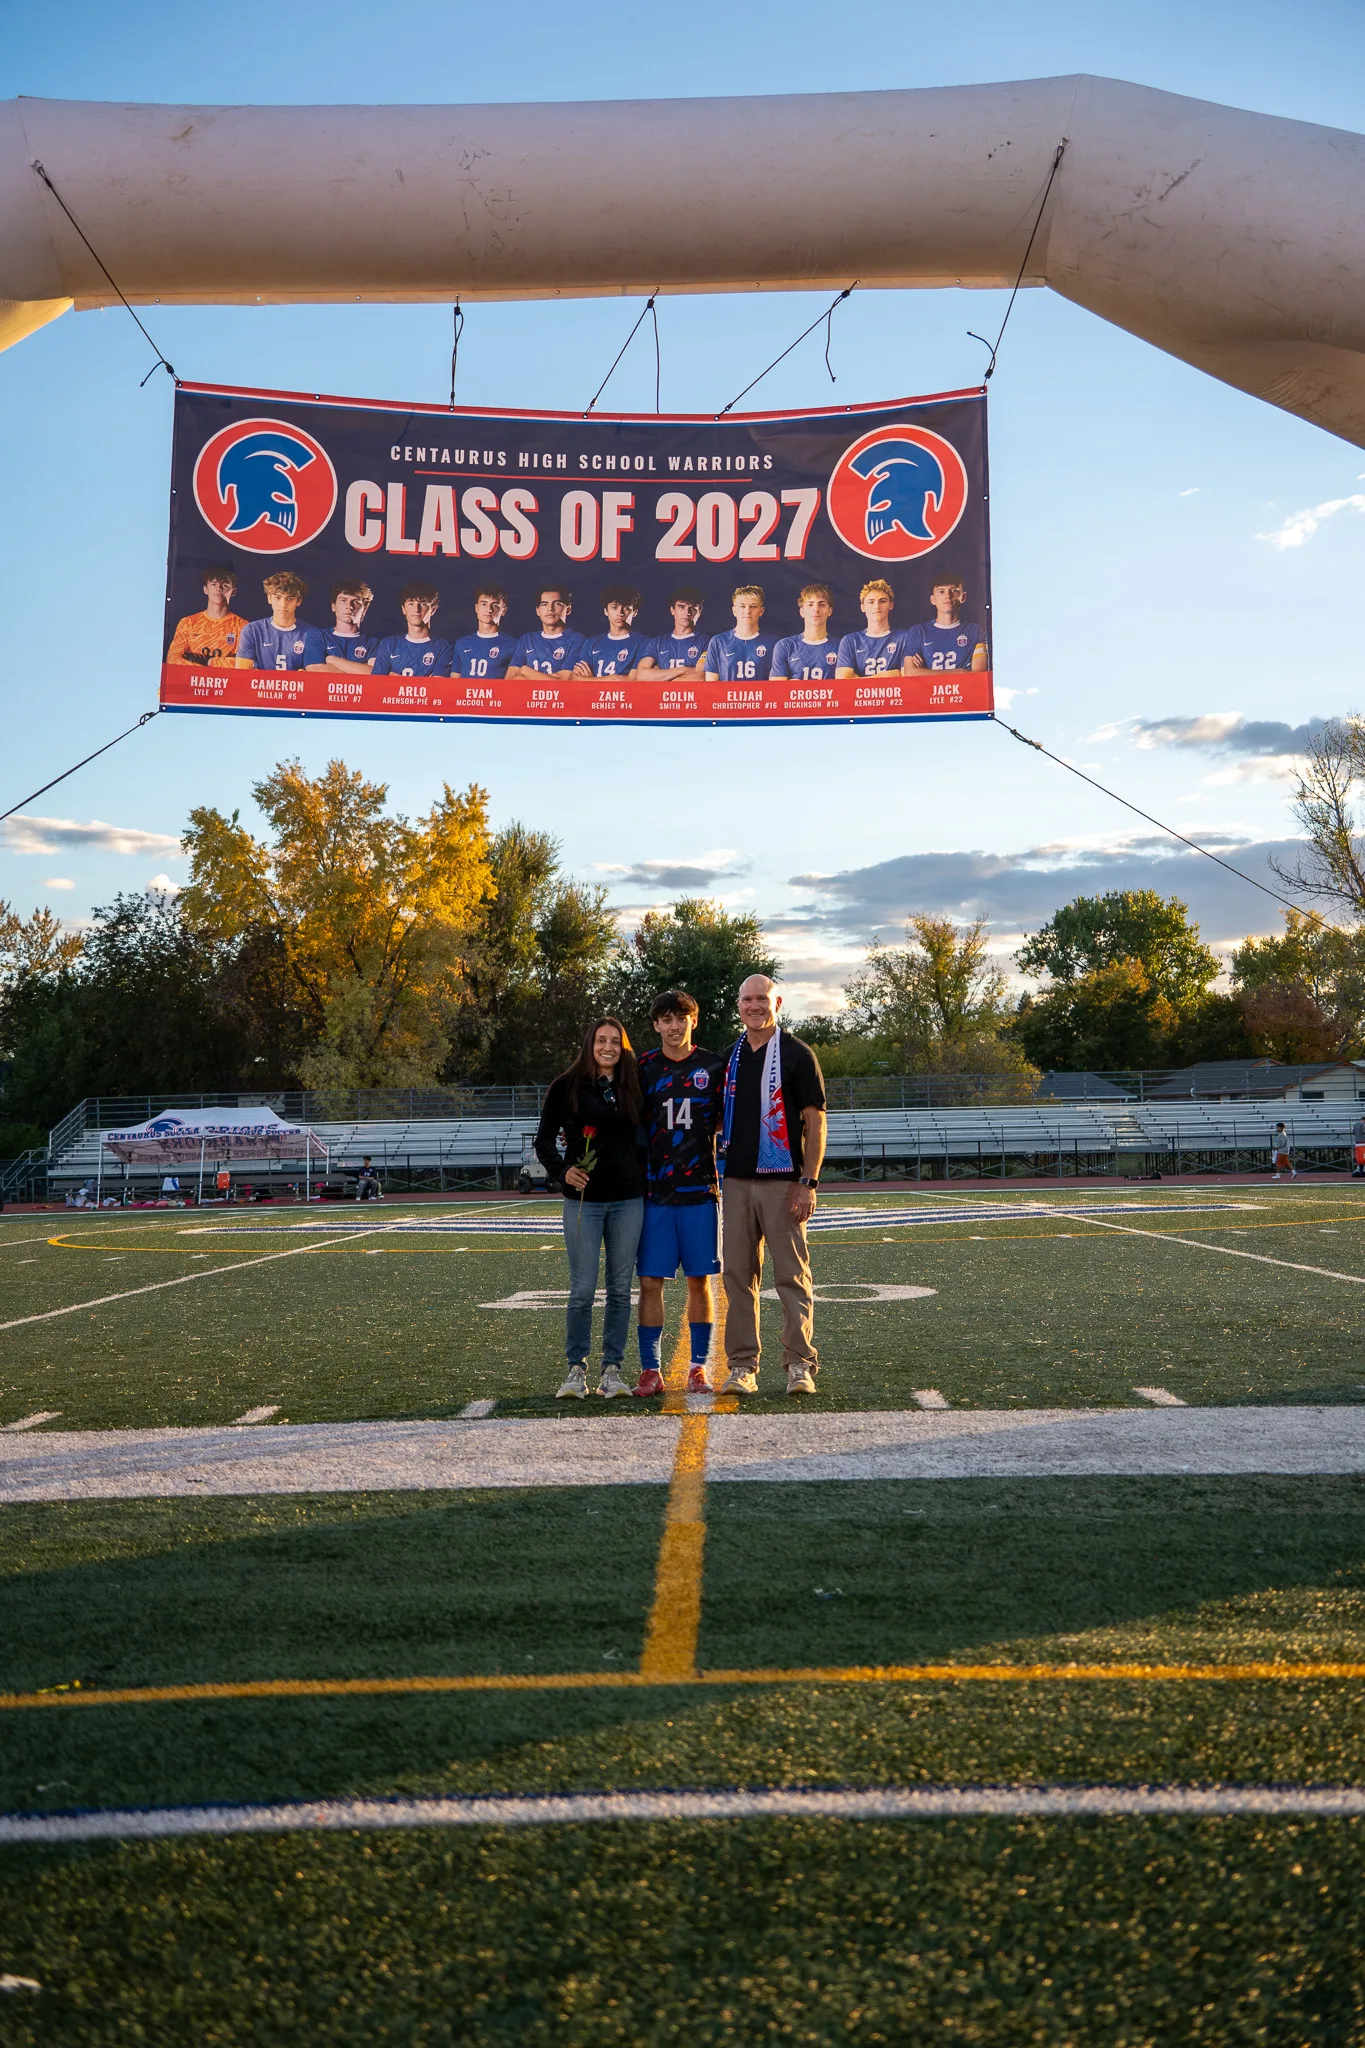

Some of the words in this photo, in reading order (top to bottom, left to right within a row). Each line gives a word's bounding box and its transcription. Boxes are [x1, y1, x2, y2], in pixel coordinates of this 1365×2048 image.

[391, 446, 506, 466] CENTAURUS
[519, 453, 566, 468] HIGH
[580, 455, 656, 470] SCHOOL
[669, 455, 772, 470] WARRIORS
[345, 480, 539, 558] CLASS
[560, 491, 634, 559] OF
[656, 488, 820, 560] 2027
[276, 655, 287, 670] 5
[865, 657, 887, 674] 22
[932, 652, 957, 670] 22
[470, 658, 488, 676] 10
[597, 659, 615, 677] 14
[737, 661, 755, 678] 16
[191, 676, 228, 688] HARRY
[251, 679, 303, 692] CAMERON
[328, 683, 362, 694] ORION
[398, 686, 427, 697] ARLO
[466, 689, 492, 698] EVAN
[856, 687, 900, 698] CONNOR
[933, 684, 959, 695] JACK
[258, 691, 282, 699] MILLAR
[533, 690, 559, 700] EDDY
[599, 692, 625, 701] ZANE
[663, 692, 694, 701] COLIN
[728, 691, 762, 701] ELIJAH
[790, 689, 833, 700] CROSBY
[930, 696, 944, 704] LYLE
[663, 1098, 692, 1129] 14
[107, 1130, 162, 1141] CENTAURUS
